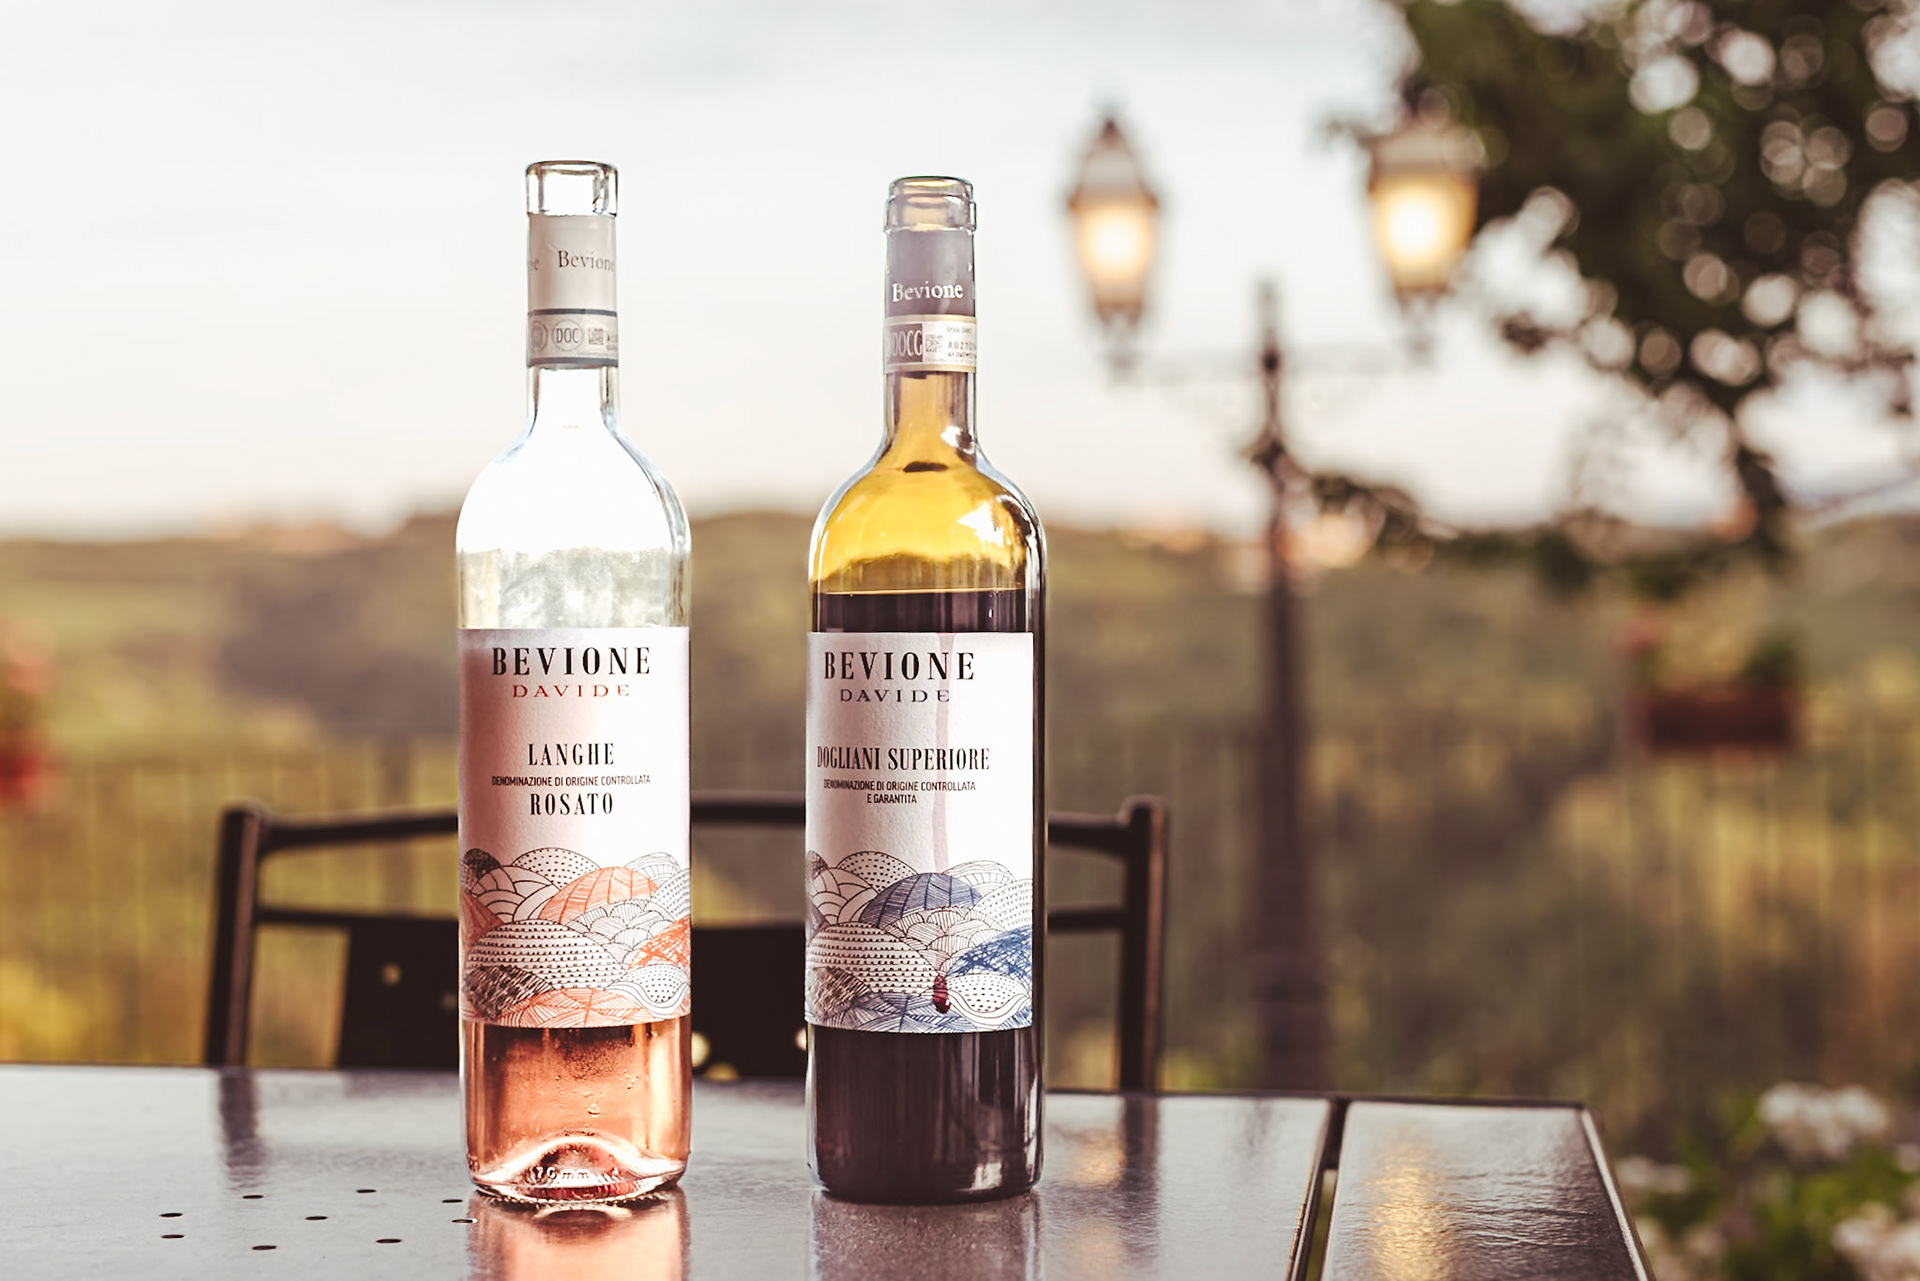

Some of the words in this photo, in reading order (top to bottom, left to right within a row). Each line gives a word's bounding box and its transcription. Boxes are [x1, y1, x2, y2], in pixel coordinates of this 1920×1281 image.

[892, 280, 964, 302] Bevione
[556, 327, 579, 344] DOC
[891, 330, 923, 357] DOCG
[492, 647, 650, 676] BEVIONE
[824, 651, 974, 680] BEVIONE
[512, 684, 630, 698] DAVIDE
[840, 688, 950, 702] DAVIDE
[528, 743, 614, 766] LANGHE
[817, 746, 880, 770] DOGLIANI
[887, 747, 990, 770] SUPERIORE
[491, 775, 553, 787] DENOMINAZIONE
[554, 776, 564, 787] DI
[565, 776, 599, 787] ORIGINE
[601, 774, 651, 786] CONTROLLATA
[823, 778, 875, 791] DENOMINAZIONE
[876, 781, 885, 791] DI
[886, 781, 919, 791] ORIGINE
[920, 780, 977, 791] CONTROLLATA
[530, 792, 613, 815] ROSATO
[867, 793, 872, 804] E
[873, 793, 918, 804] GARANTITA
